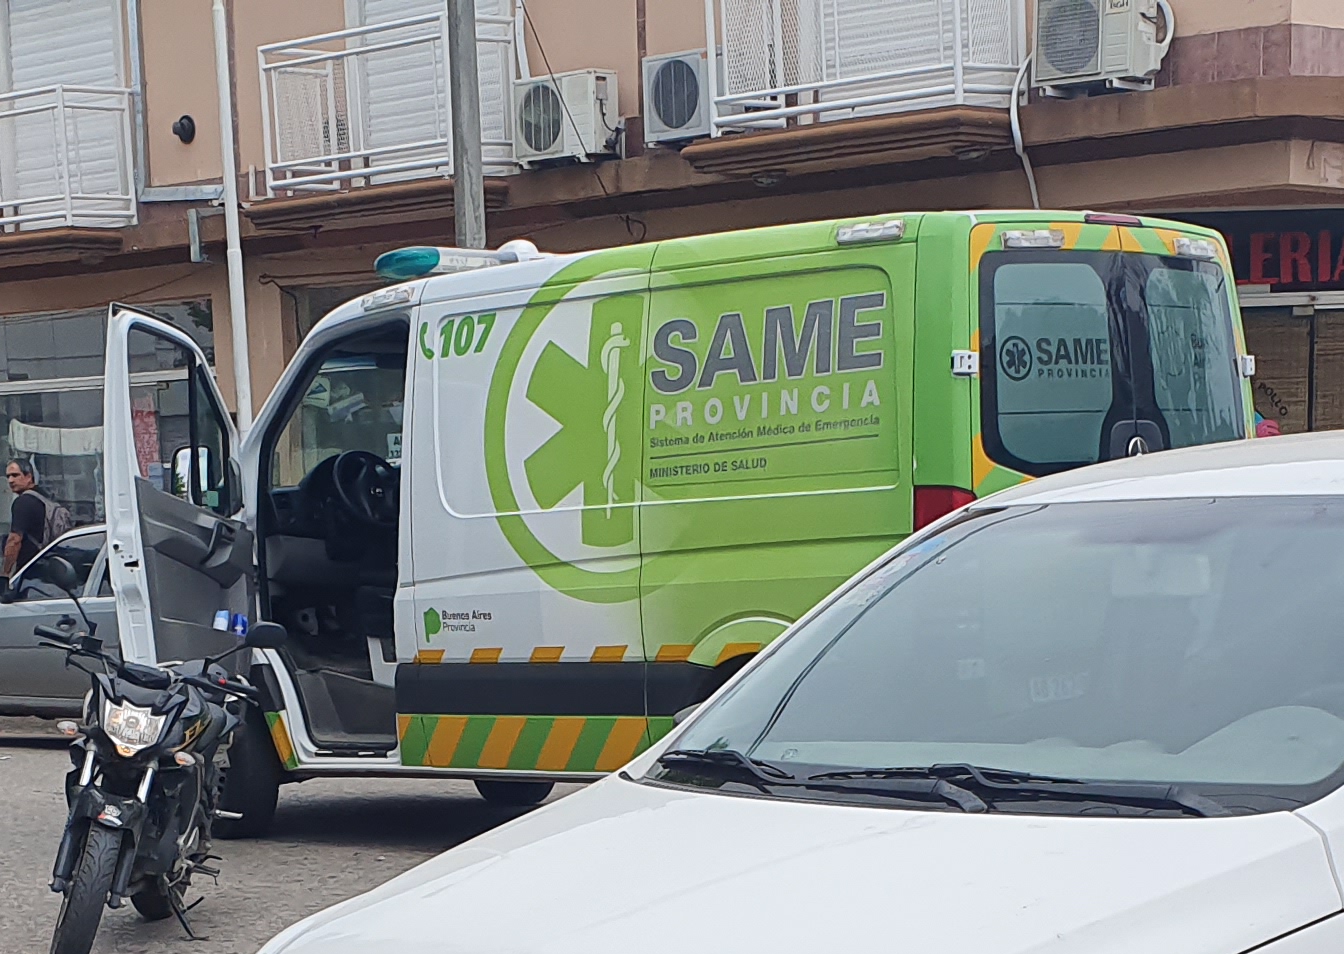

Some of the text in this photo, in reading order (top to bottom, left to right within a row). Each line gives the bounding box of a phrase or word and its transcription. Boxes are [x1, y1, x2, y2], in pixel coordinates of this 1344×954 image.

[440, 312, 497, 359] 107
[650, 291, 886, 395] SAME
[1036, 337, 1110, 366] SAME
[649, 380, 881, 430] PROVINCIA
[650, 414, 880, 449] Sistema de Atención Médica de Emergencia
[649, 457, 767, 479] MINISTERIO DE SALUD
[441, 610, 492, 620] Buenos Aires
[442, 621, 476, 632] Provincia
